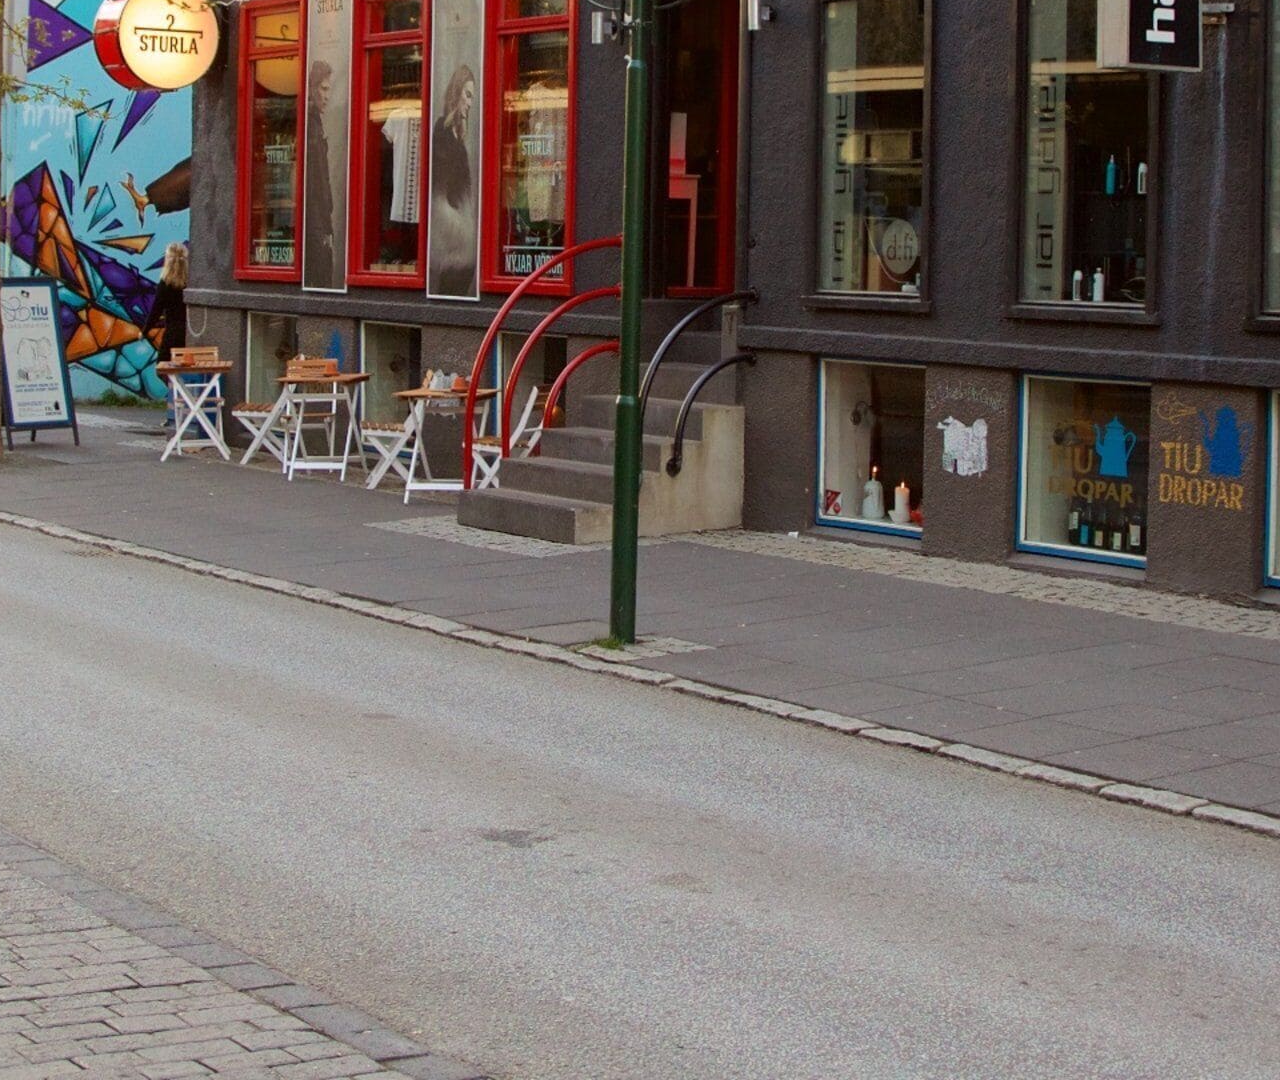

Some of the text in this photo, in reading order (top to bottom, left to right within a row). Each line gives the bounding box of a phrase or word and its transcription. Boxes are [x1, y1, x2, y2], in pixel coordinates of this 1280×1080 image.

[139, 34, 199, 55] STURLA
[505, 251, 532, 273] NÝJAR
[1159, 473, 1245, 510] DROPAR
